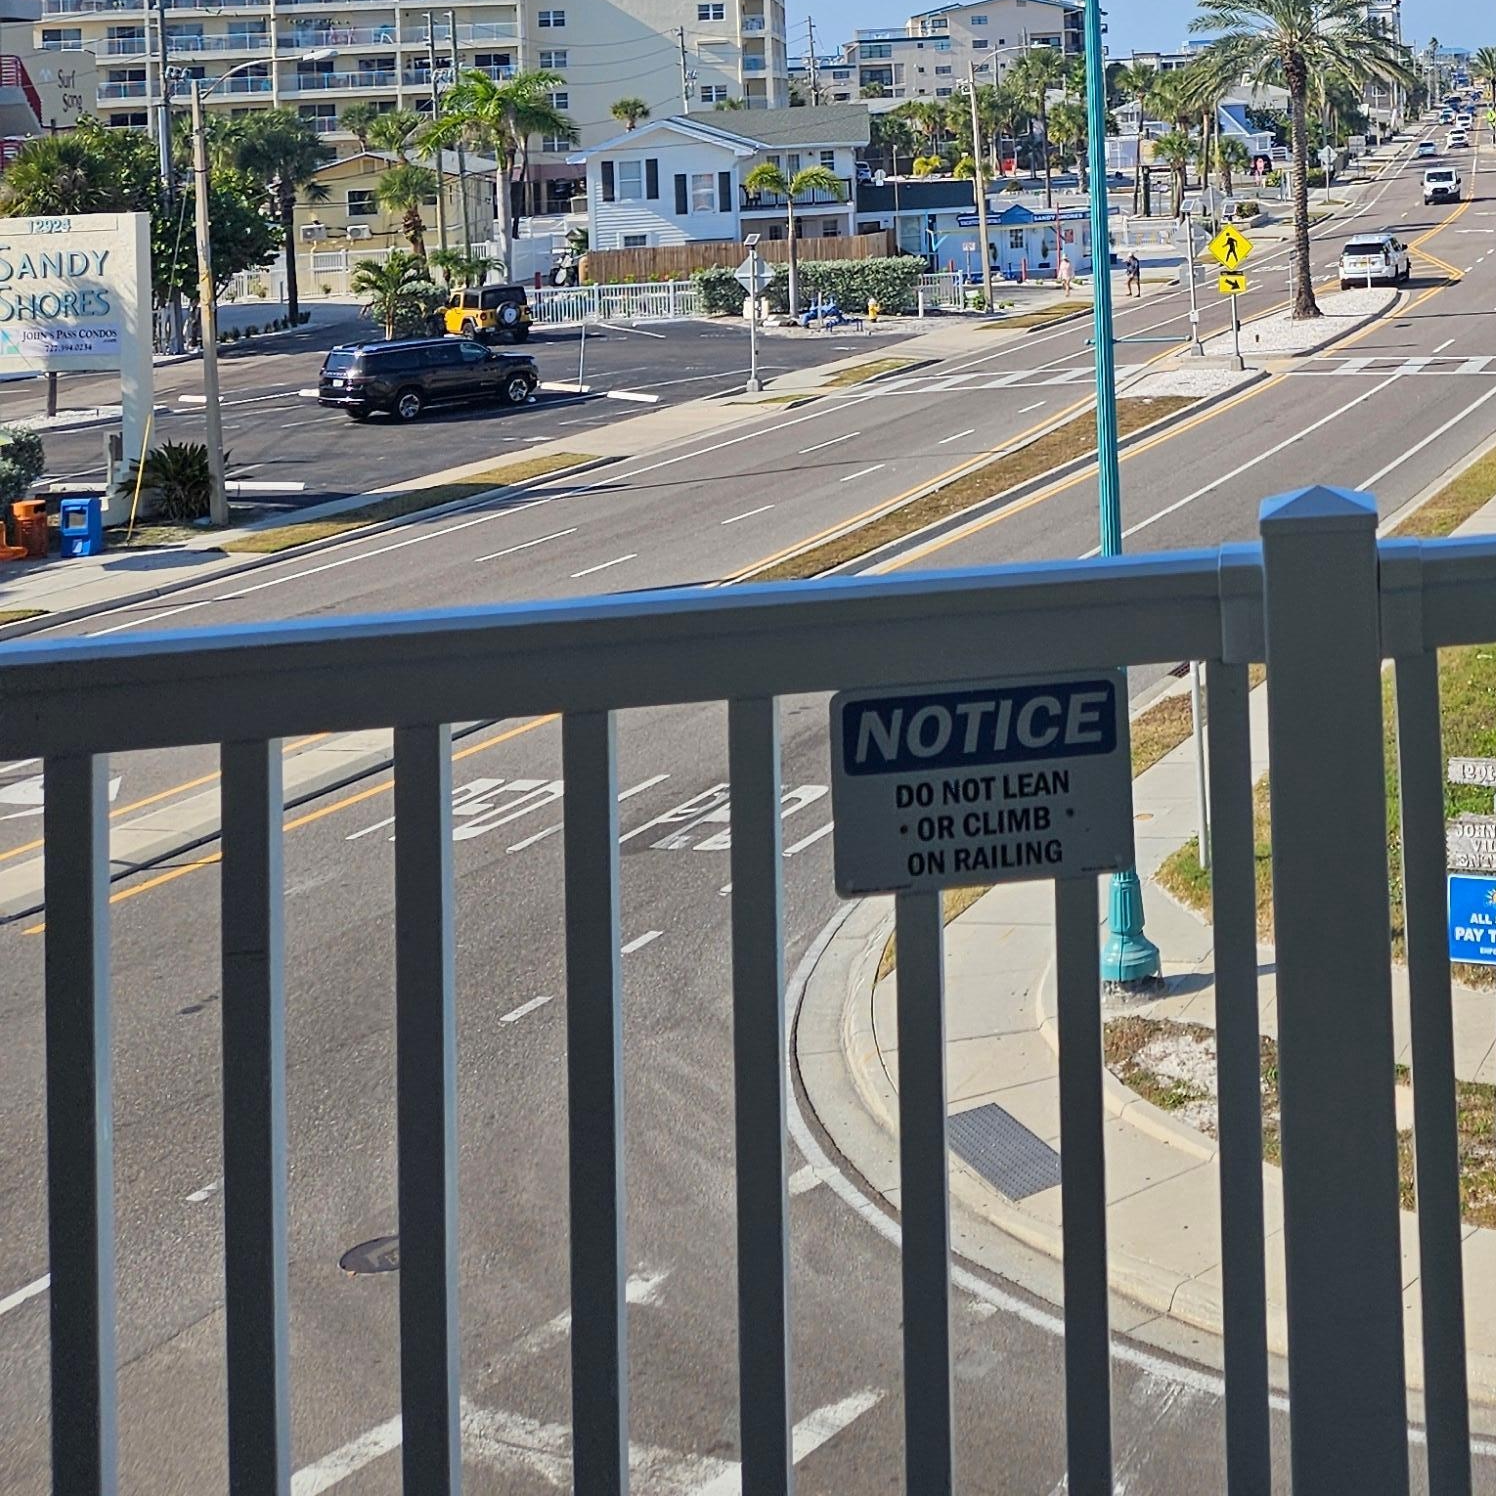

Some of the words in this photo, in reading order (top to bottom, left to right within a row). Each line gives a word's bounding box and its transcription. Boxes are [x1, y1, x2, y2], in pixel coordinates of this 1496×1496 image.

[855, 689, 1109, 764] NOTICE
[895, 782, 934, 809] DO
[942, 776, 996, 804] NOT
[1002, 769, 1070, 801] LEAN
[917, 815, 955, 842] OR
[963, 806, 1051, 837] CLIMB
[907, 850, 945, 877] ON
[953, 839, 1063, 873] RAILING
[1455, 926, 1484, 942] PAY
[1470, 913, 1492, 925] ALL
